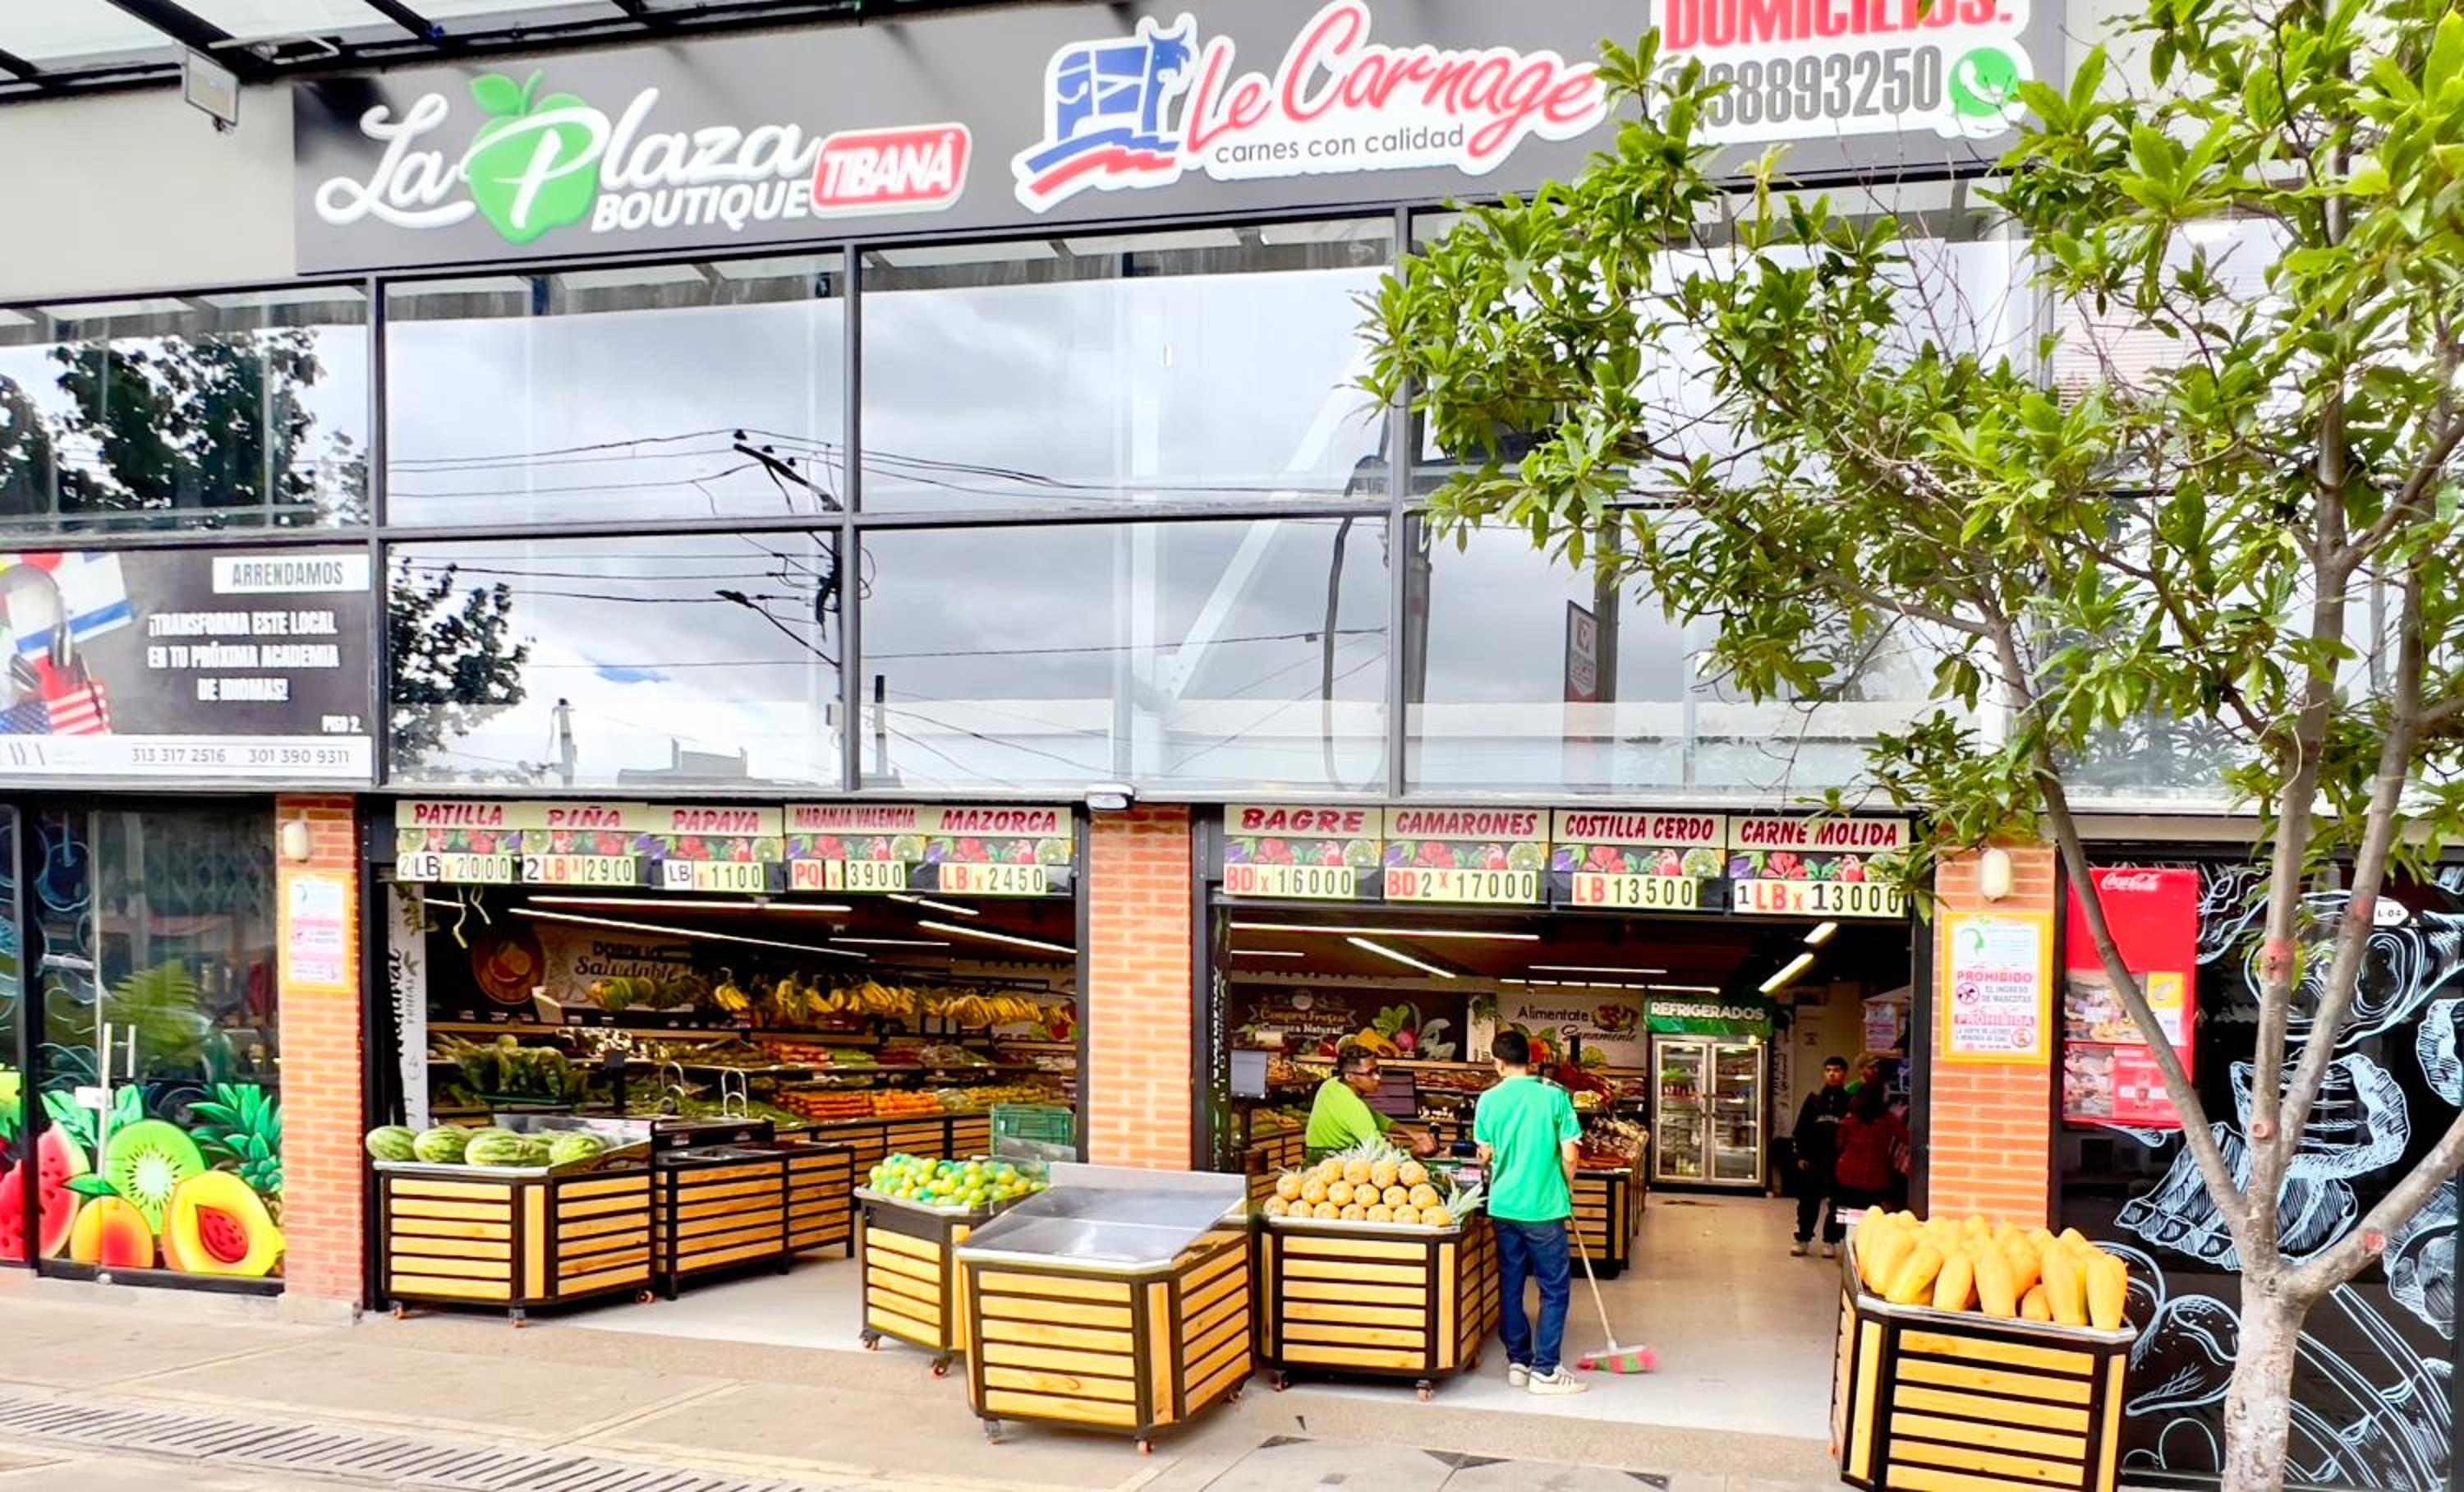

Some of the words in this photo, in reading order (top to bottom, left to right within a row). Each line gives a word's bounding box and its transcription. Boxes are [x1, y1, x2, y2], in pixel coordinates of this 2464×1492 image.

[1187, 44, 1271, 154] Le
[1281, 5, 1602, 159] Carnage
[1215, 140, 1299, 164] carnes
[1308, 134, 1357, 158] con
[1363, 126, 1464, 154] calidad
[315, 93, 476, 229] La
[461, 87, 820, 229] Plaza
[822, 130, 956, 202] TIBANÁ
[591, 182, 813, 233] BOUTIQUE
[232, 562, 343, 586] ARRENDAMOS
[148, 612, 250, 637] ¡TRANSFORMA
[251, 611, 288, 635] ESTE
[290, 611, 338, 635] LOCAL
[148, 646, 167, 668] EN
[169, 646, 188, 668] TU
[191, 640, 259, 668] PRÓXIMA
[261, 644, 340, 668] ACADEMIA
[197, 678, 218, 701] DE
[219, 678, 289, 701] IDIOMAS!
[131, 748, 155, 762] 313
[162, 748, 185, 762] 317
[191, 748, 226, 762] 2516
[249, 748, 274, 763] 301
[280, 748, 311, 763] 390
[316, 748, 349, 763] 9311
[414, 804, 503, 826] PATILLA
[547, 805, 621, 827] PIÑA
[672, 809, 759, 832] PAPAYA
[794, 808, 852, 830] NARANJA
[855, 808, 917, 830] VALENCIA
[940, 809, 1057, 832] MAZORCA
[1241, 808, 1364, 833] BAGRE
[1396, 812, 1538, 836] CAMARONES
[1565, 814, 1645, 839] COSTILLA
[1653, 817, 1714, 841] CERDO
[1740, 820, 1808, 845] CARNE
[1815, 822, 1898, 847] MOLIDA
[457, 857, 508, 879] 2000
[712, 865, 760, 888] 1100
[795, 865, 821, 888] PQ
[849, 865, 903, 888] 3900
[988, 868, 1043, 893] 2450
[1279, 868, 1353, 896] 16000
[1457, 873, 1533, 900] 17000
[1575, 876, 1606, 904] LB
[1614, 877, 1694, 906] 13500
[1812, 883, 1899, 914] 13000
[1957, 970, 2033, 983] PROHIBIDO
[1518, 1003, 1589, 1021] Alimentate
[1650, 1001, 1765, 1020] REFRIGERADOS
